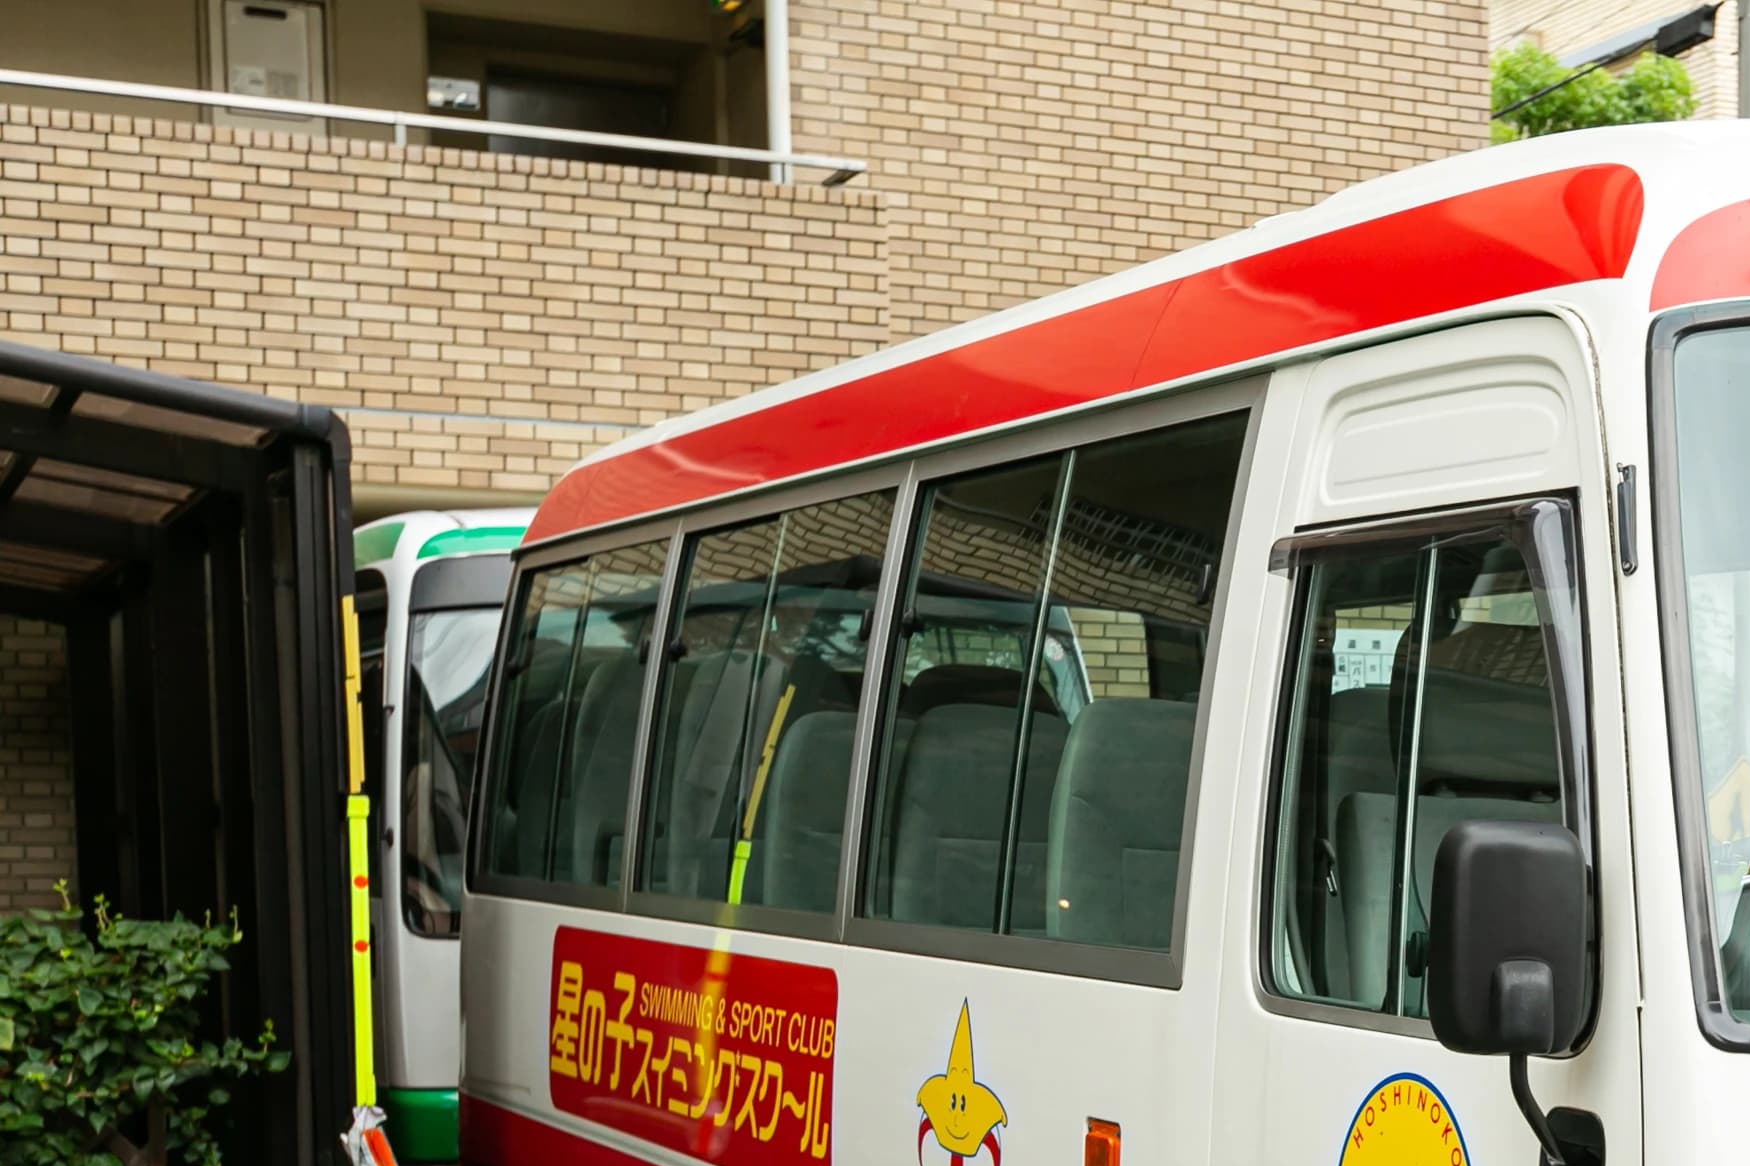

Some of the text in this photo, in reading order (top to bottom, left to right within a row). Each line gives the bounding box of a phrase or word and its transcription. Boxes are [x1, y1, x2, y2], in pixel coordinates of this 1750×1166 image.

[640, 982, 835, 1060] SWIMMING & SPORT CLUB
